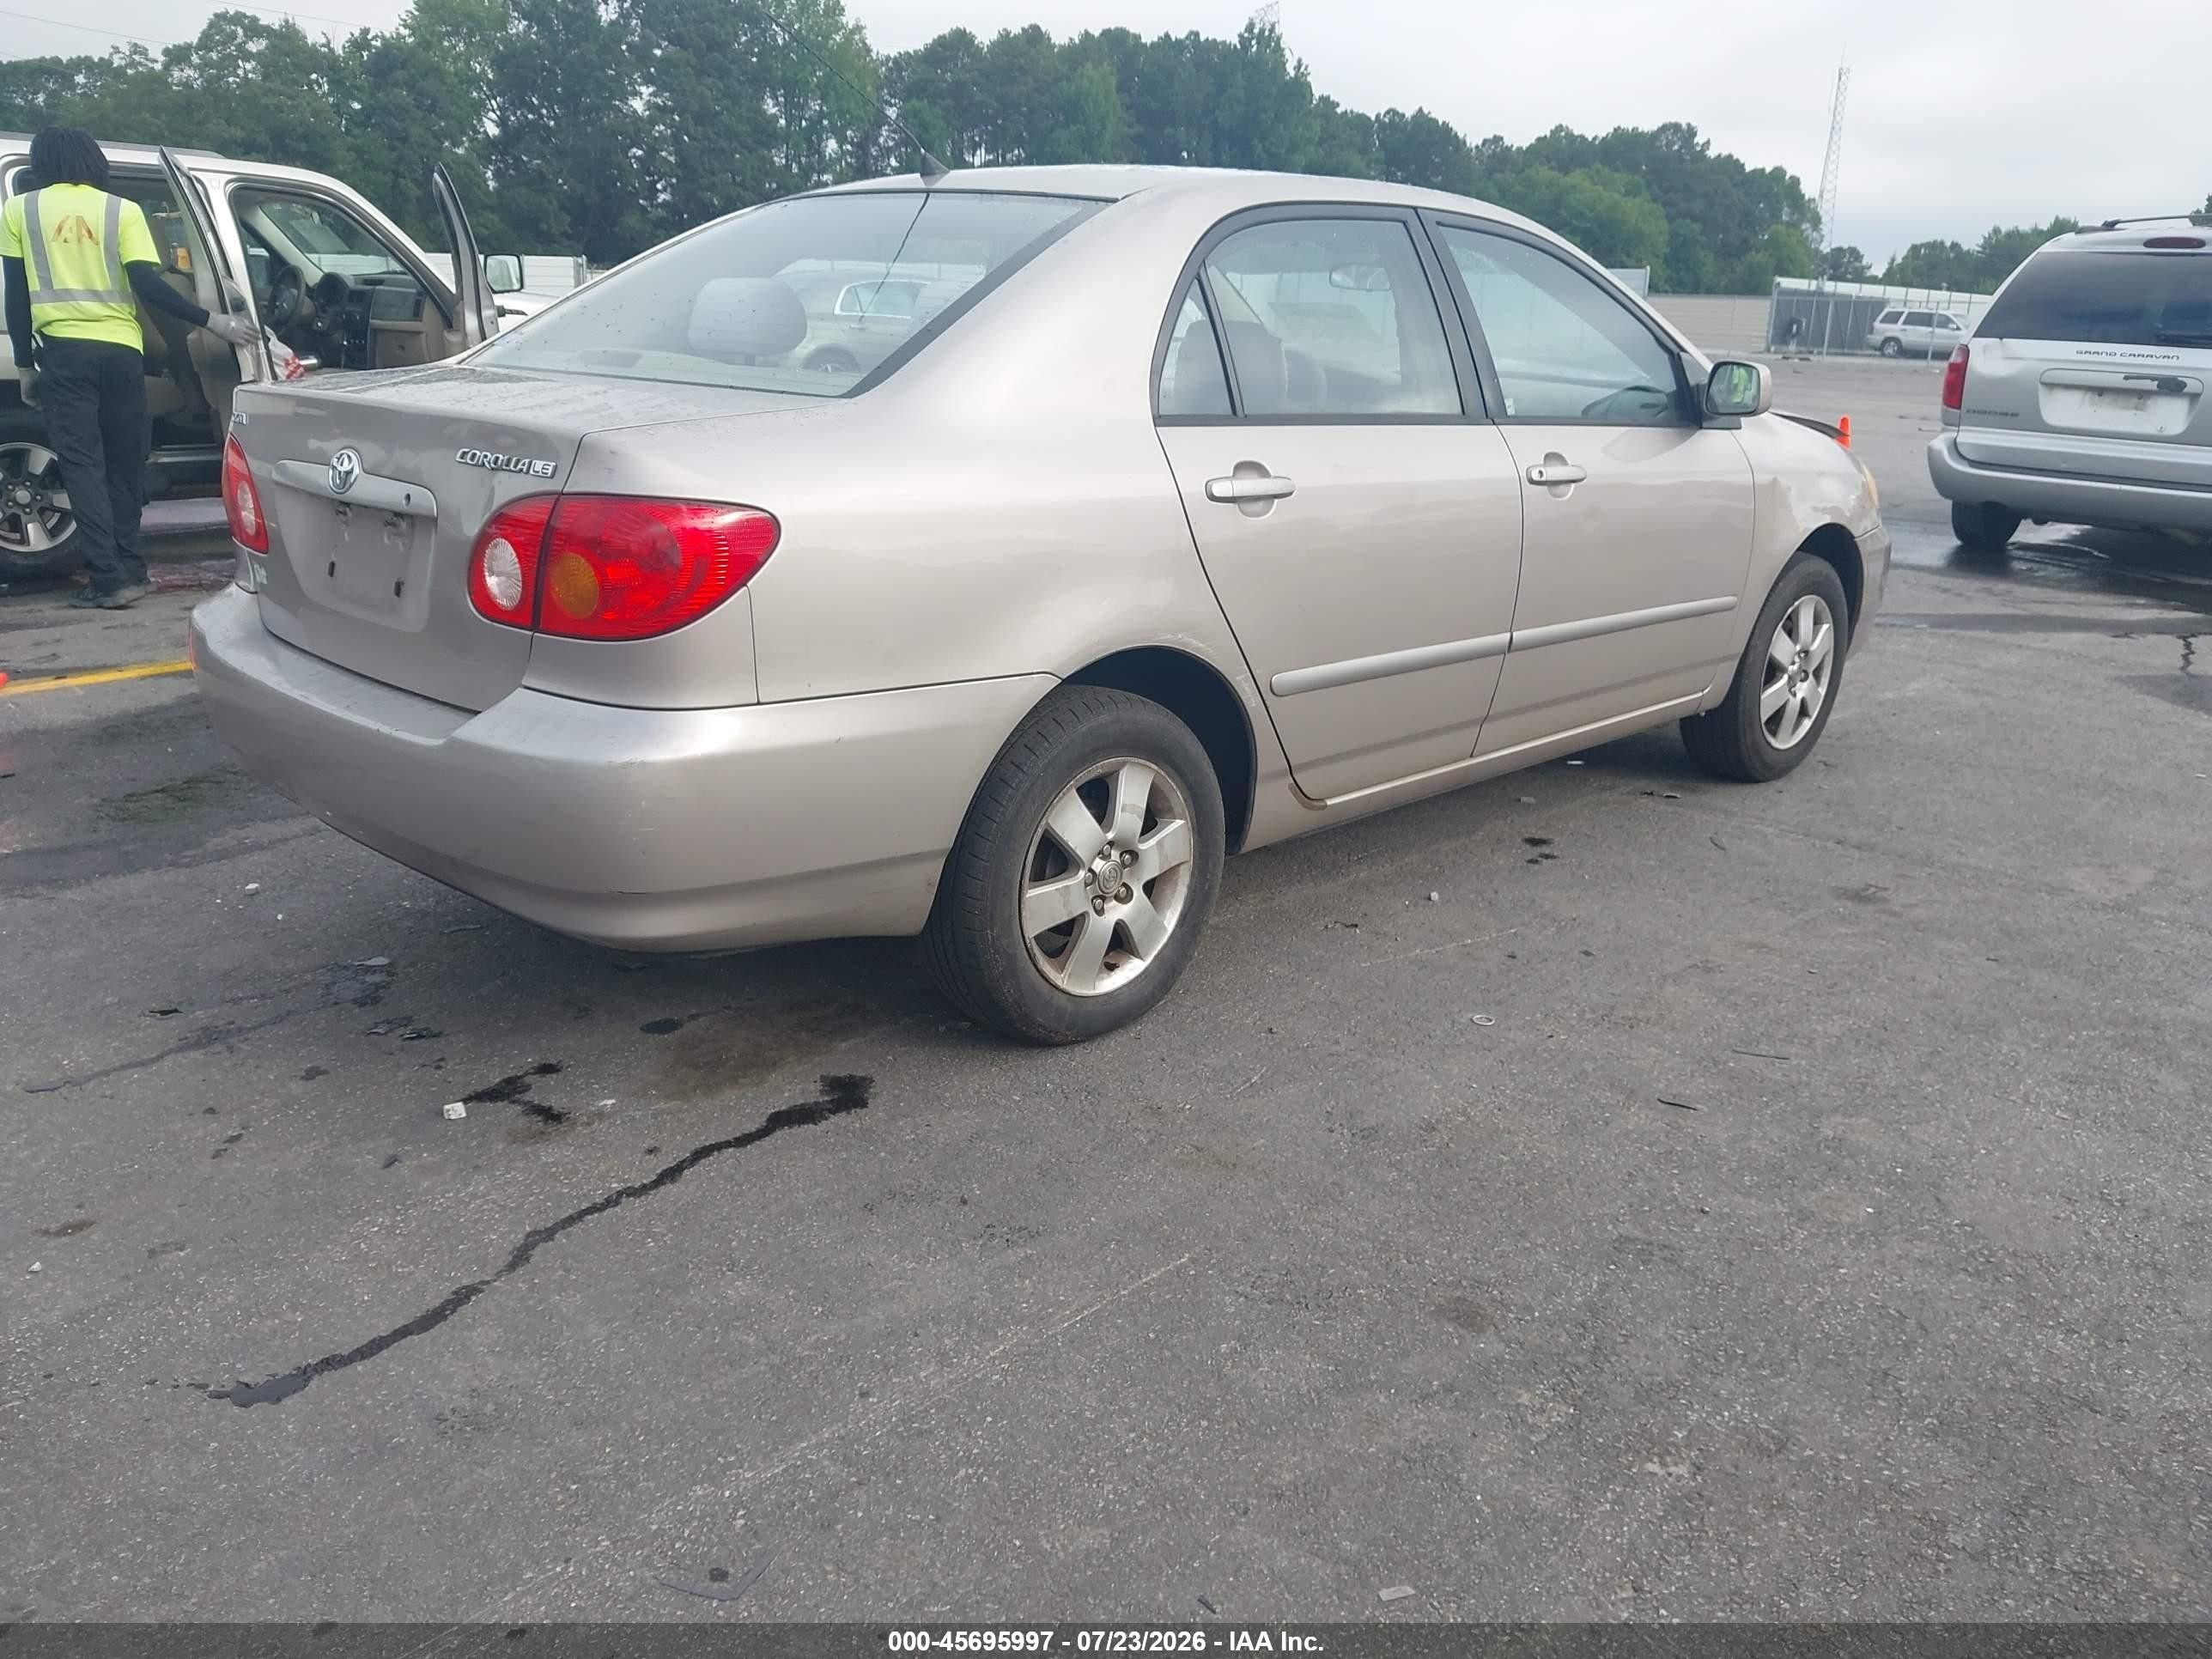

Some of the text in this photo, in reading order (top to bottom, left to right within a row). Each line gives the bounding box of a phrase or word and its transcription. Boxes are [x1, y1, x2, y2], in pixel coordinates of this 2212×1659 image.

[2075, 349, 2180, 361] GRAND CARAVAN
[455, 447, 557, 478] COROLLA LE
